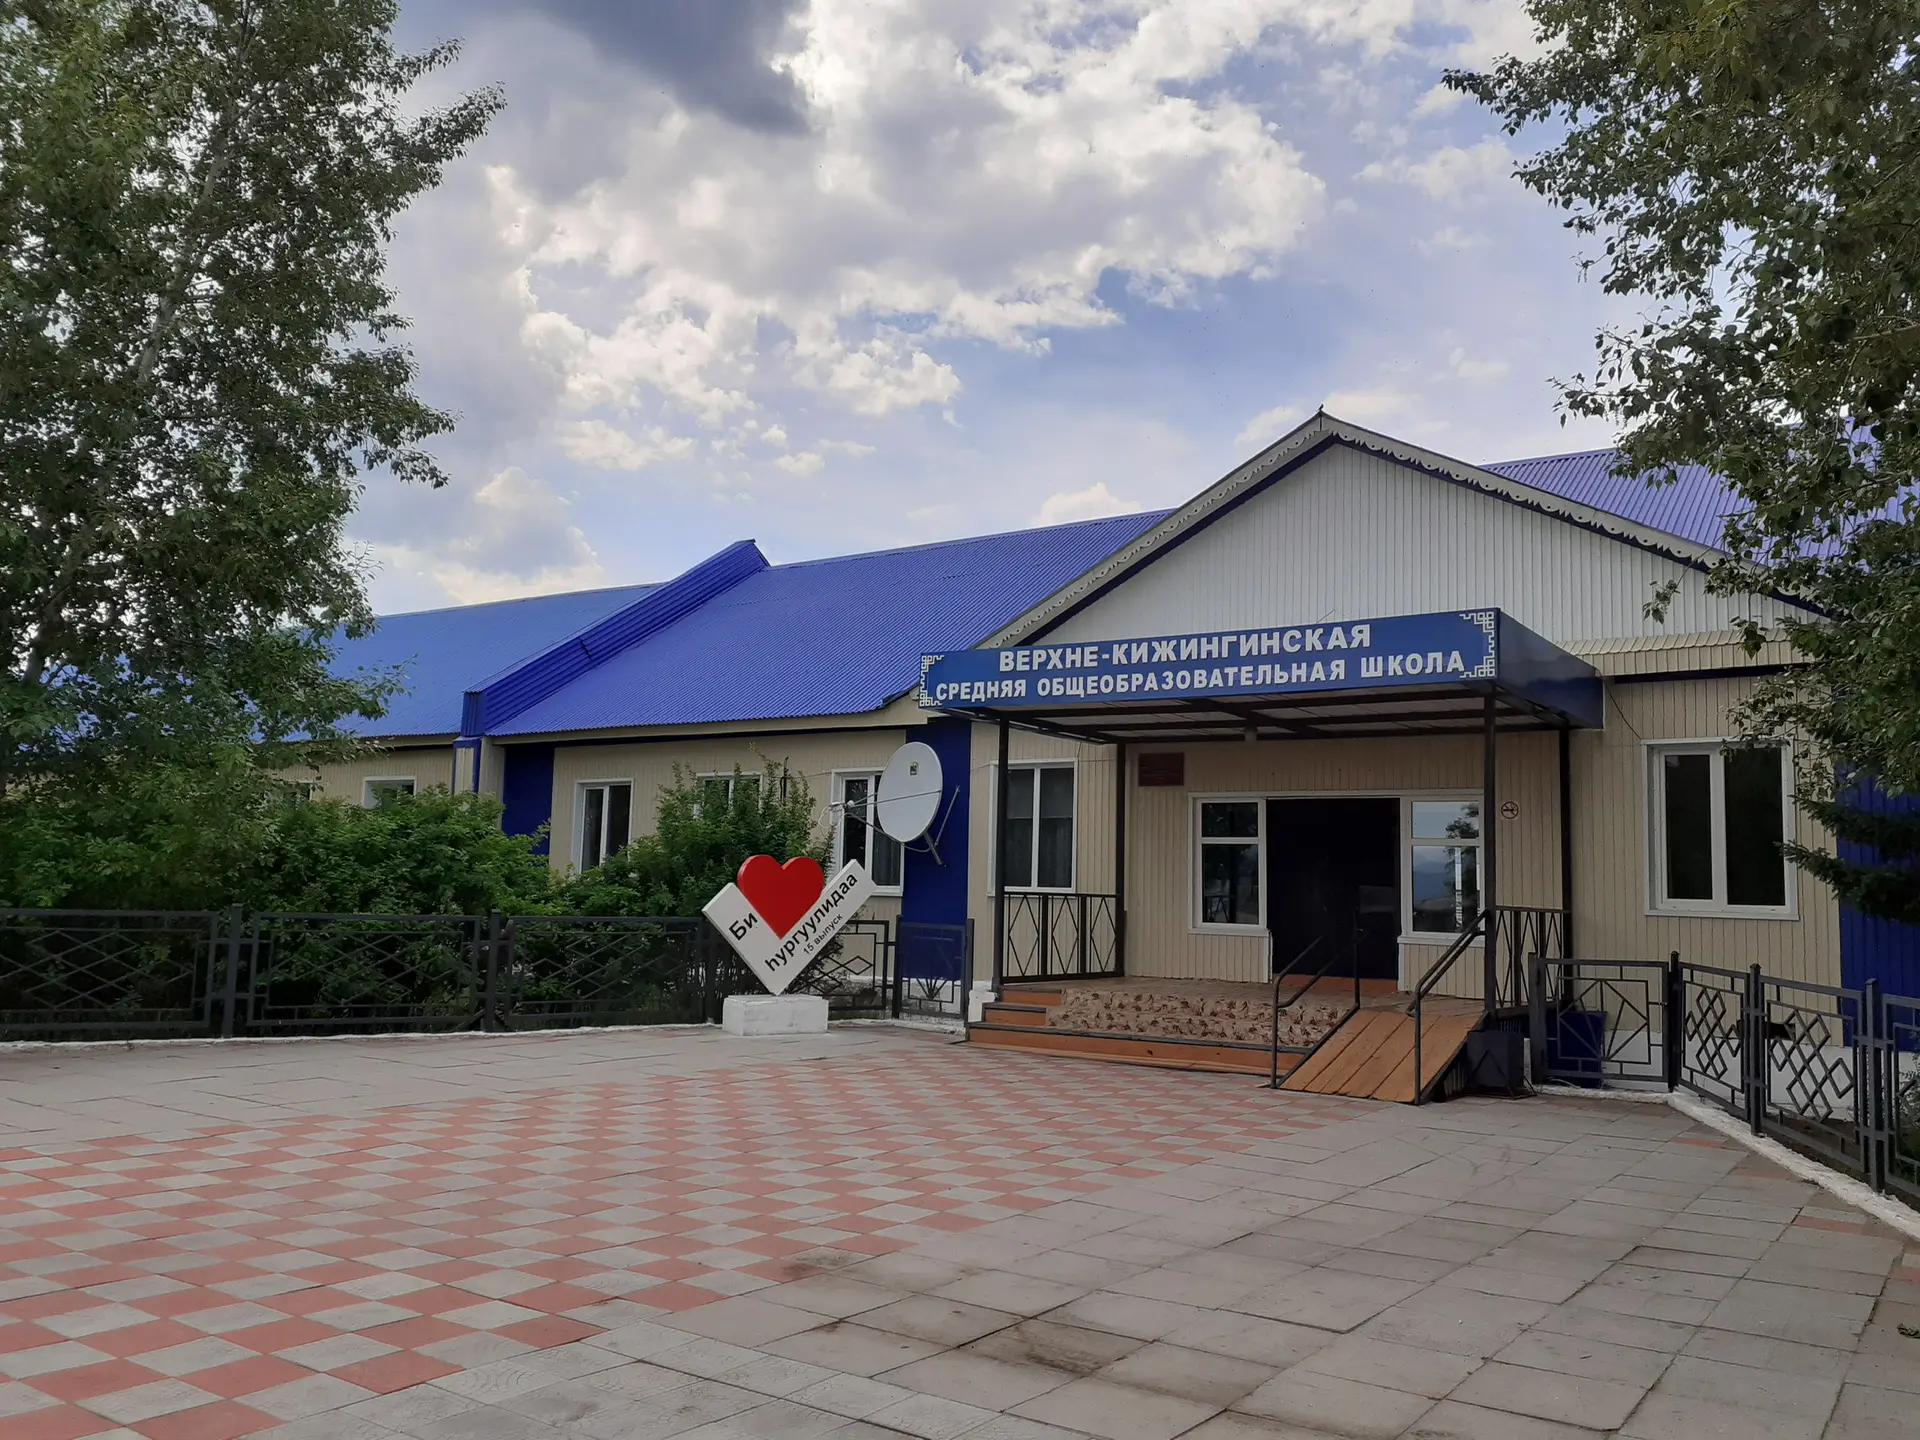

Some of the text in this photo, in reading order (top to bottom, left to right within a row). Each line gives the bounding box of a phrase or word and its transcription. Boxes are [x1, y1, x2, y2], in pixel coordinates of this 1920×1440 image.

[999, 623, 1371, 672] ВЕРХНЕ-КИЖИНГИНСКАЯ
[936, 651, 1465, 702] СРЕДНЯЯ ОБЩЕОБРАЗОВАТЕЛЬНАЯ ШКОЛА
[728, 912, 758, 941] Би
[803, 913, 843, 955] 15 выпуск
